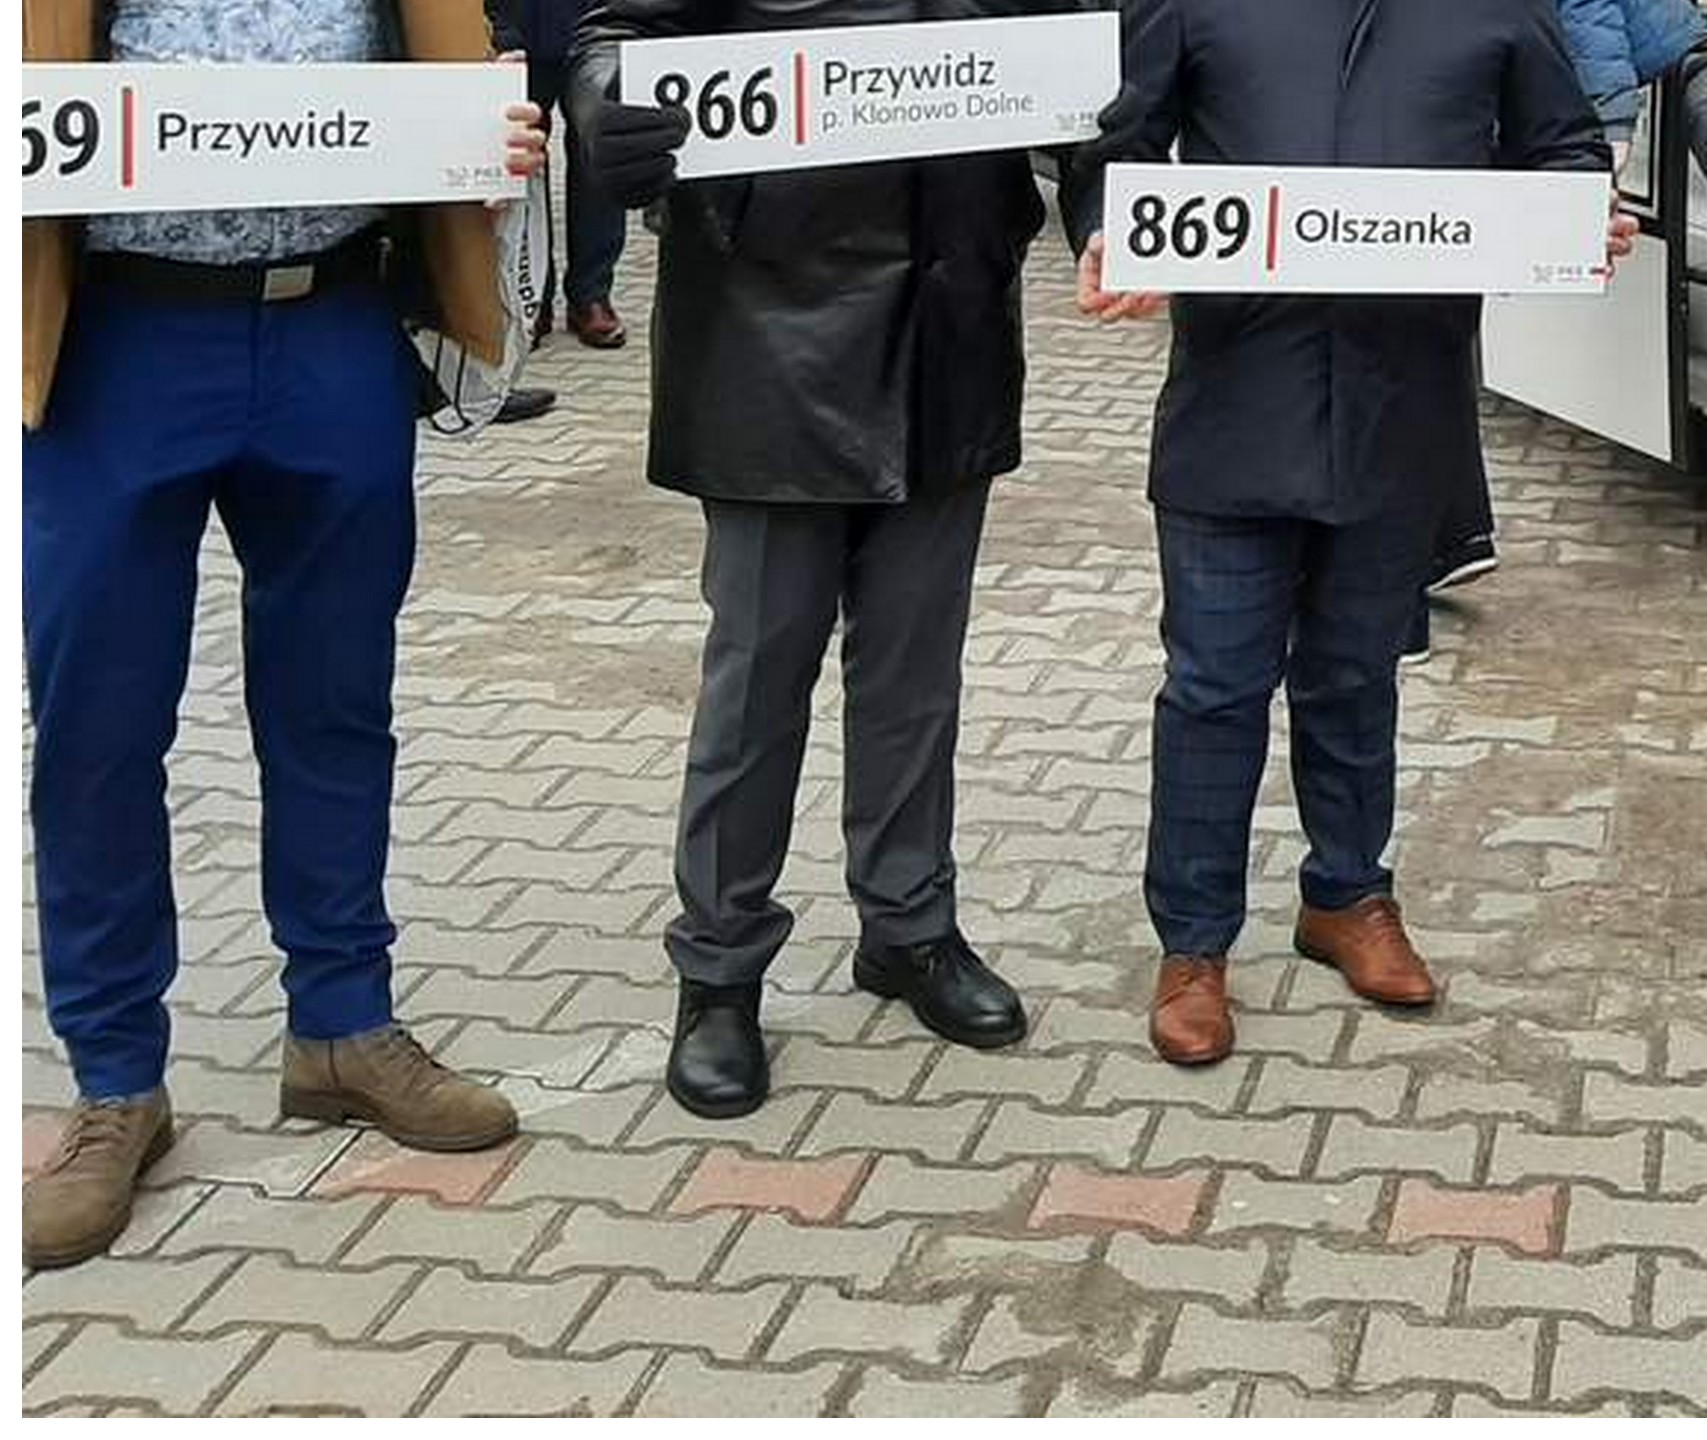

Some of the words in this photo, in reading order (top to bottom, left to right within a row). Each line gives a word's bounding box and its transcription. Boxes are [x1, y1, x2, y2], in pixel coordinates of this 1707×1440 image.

[654, 67, 777, 140] 866
[823, 53, 997, 99] Przywidz
[822, 110, 844, 132] p.
[965, 91, 1035, 118] Dolne
[157, 109, 371, 158] Przywidz
[1127, 194, 1251, 260] 869
[1295, 207, 1473, 246] Olszanka
